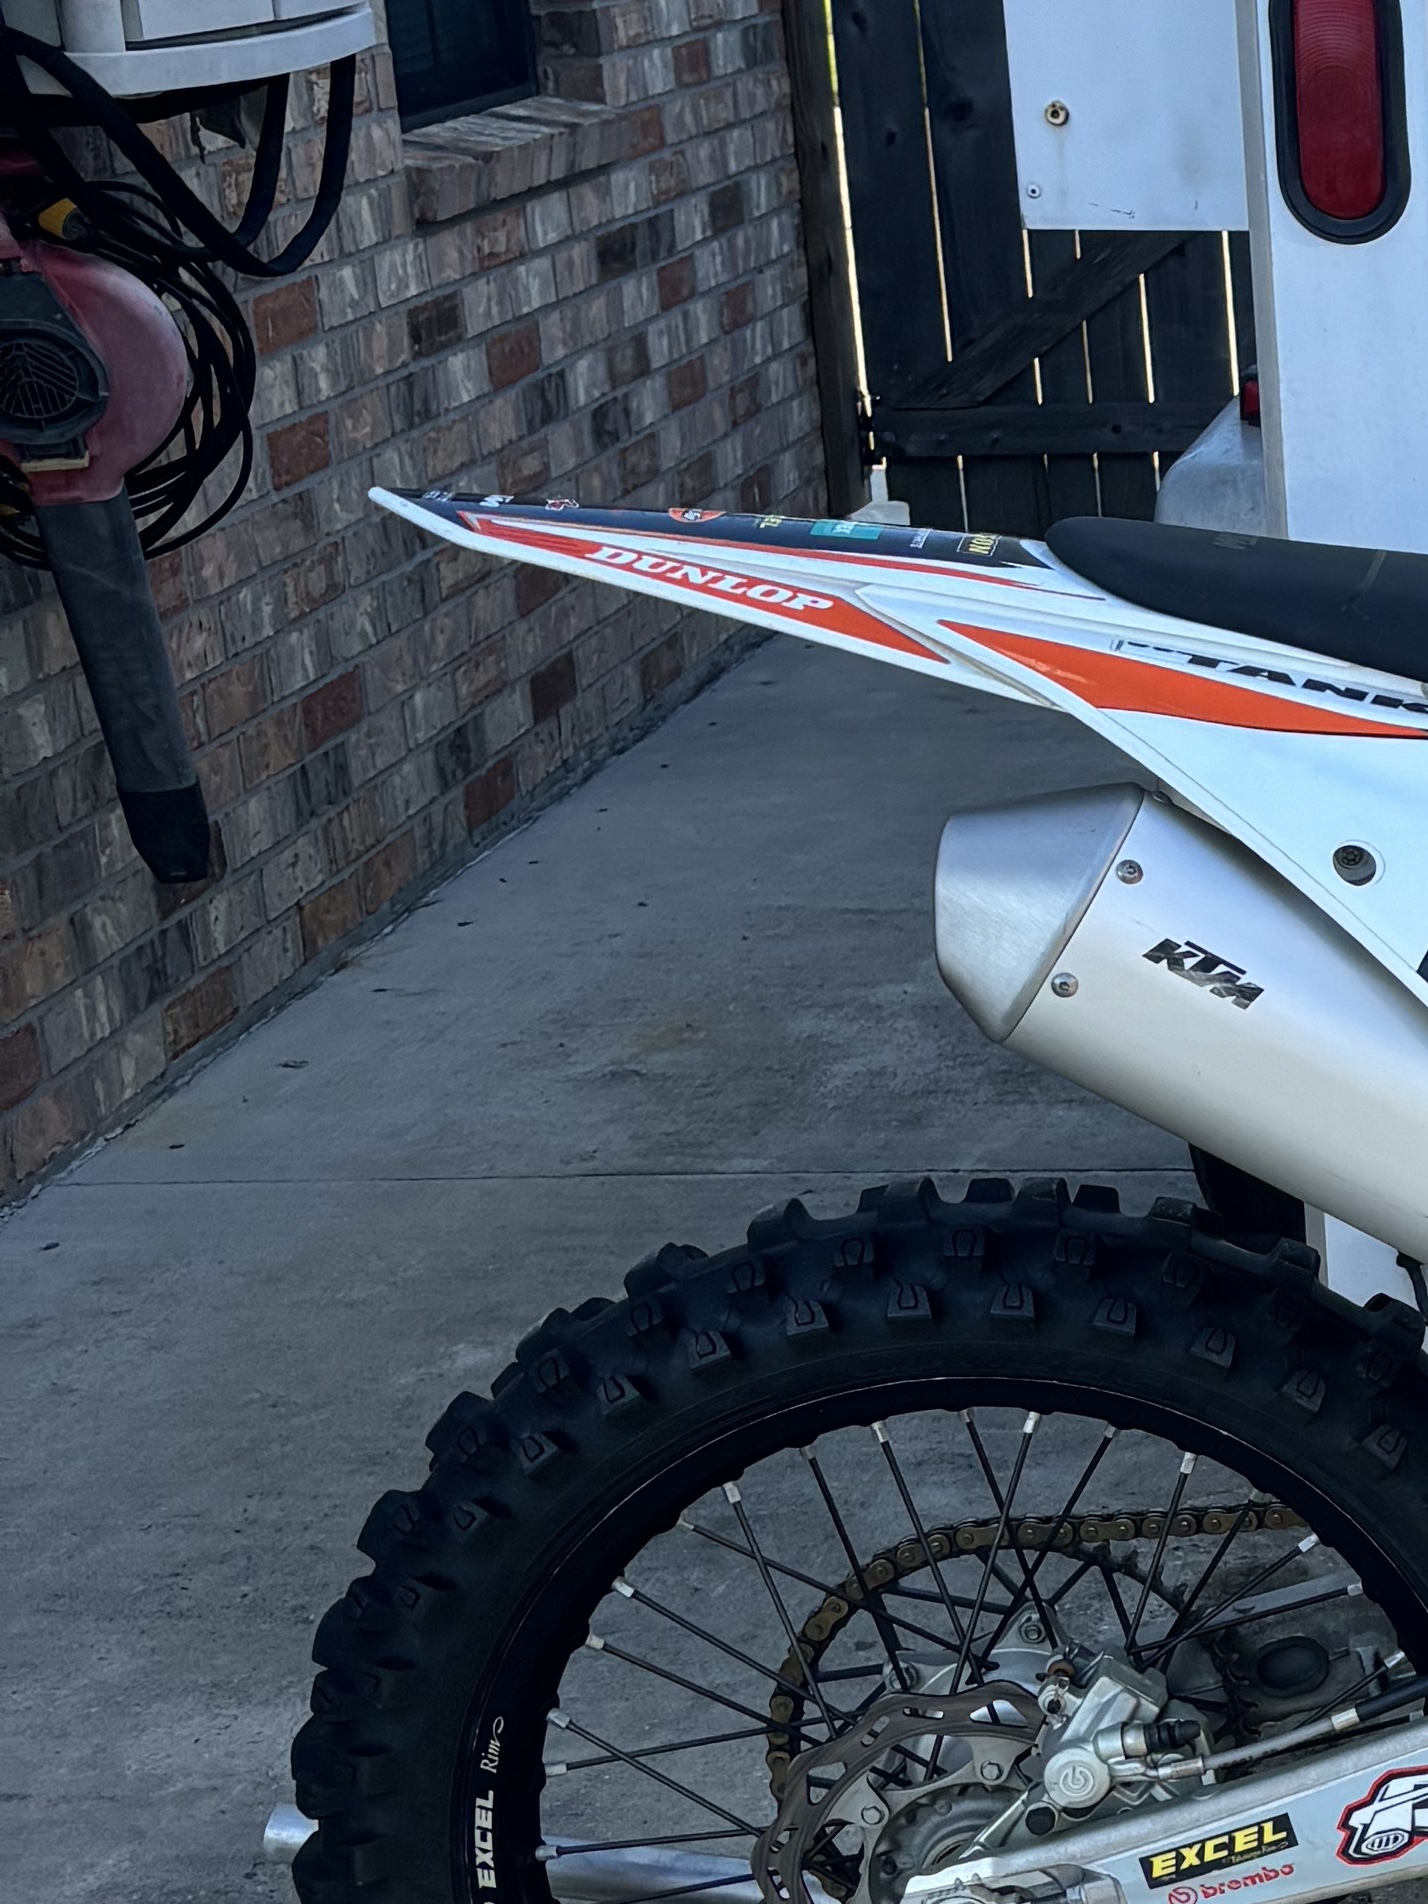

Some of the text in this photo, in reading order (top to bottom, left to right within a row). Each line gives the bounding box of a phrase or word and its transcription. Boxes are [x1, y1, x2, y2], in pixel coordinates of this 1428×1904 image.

[585, 546, 834, 611] DUNLOP
[1142, 938, 1265, 1010] KTM
[479, 1716, 505, 1774] Rim
[474, 1790, 497, 1889] EXCEL
[1149, 1821, 1288, 1879] EXCEL
[1199, 1863, 1294, 1900] brembo
